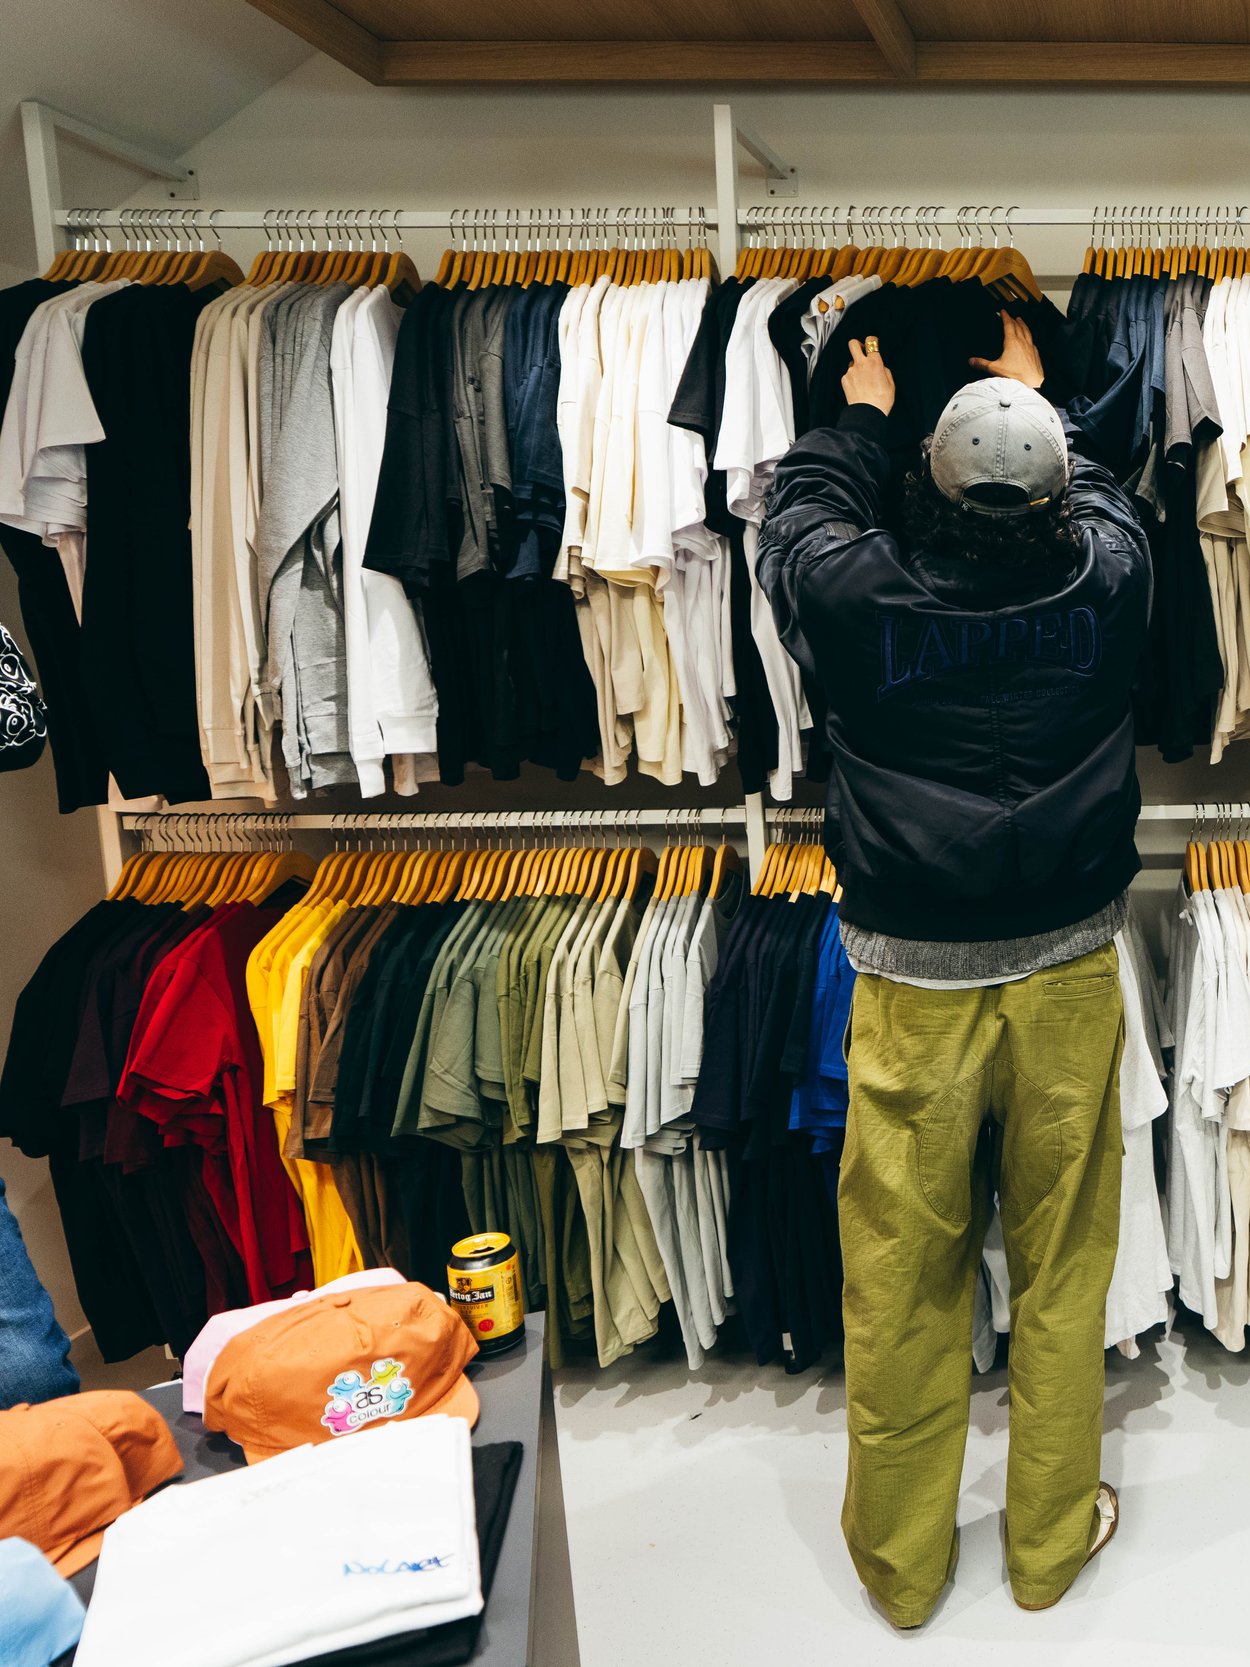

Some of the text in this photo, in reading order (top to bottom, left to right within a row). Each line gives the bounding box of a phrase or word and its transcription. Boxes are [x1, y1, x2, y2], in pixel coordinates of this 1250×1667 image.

[875, 604, 1102, 703] LAPPED
[471, 1291, 492, 1303] Jan
[355, 1387, 383, 1409] as
[350, 1403, 391, 1424] colour
